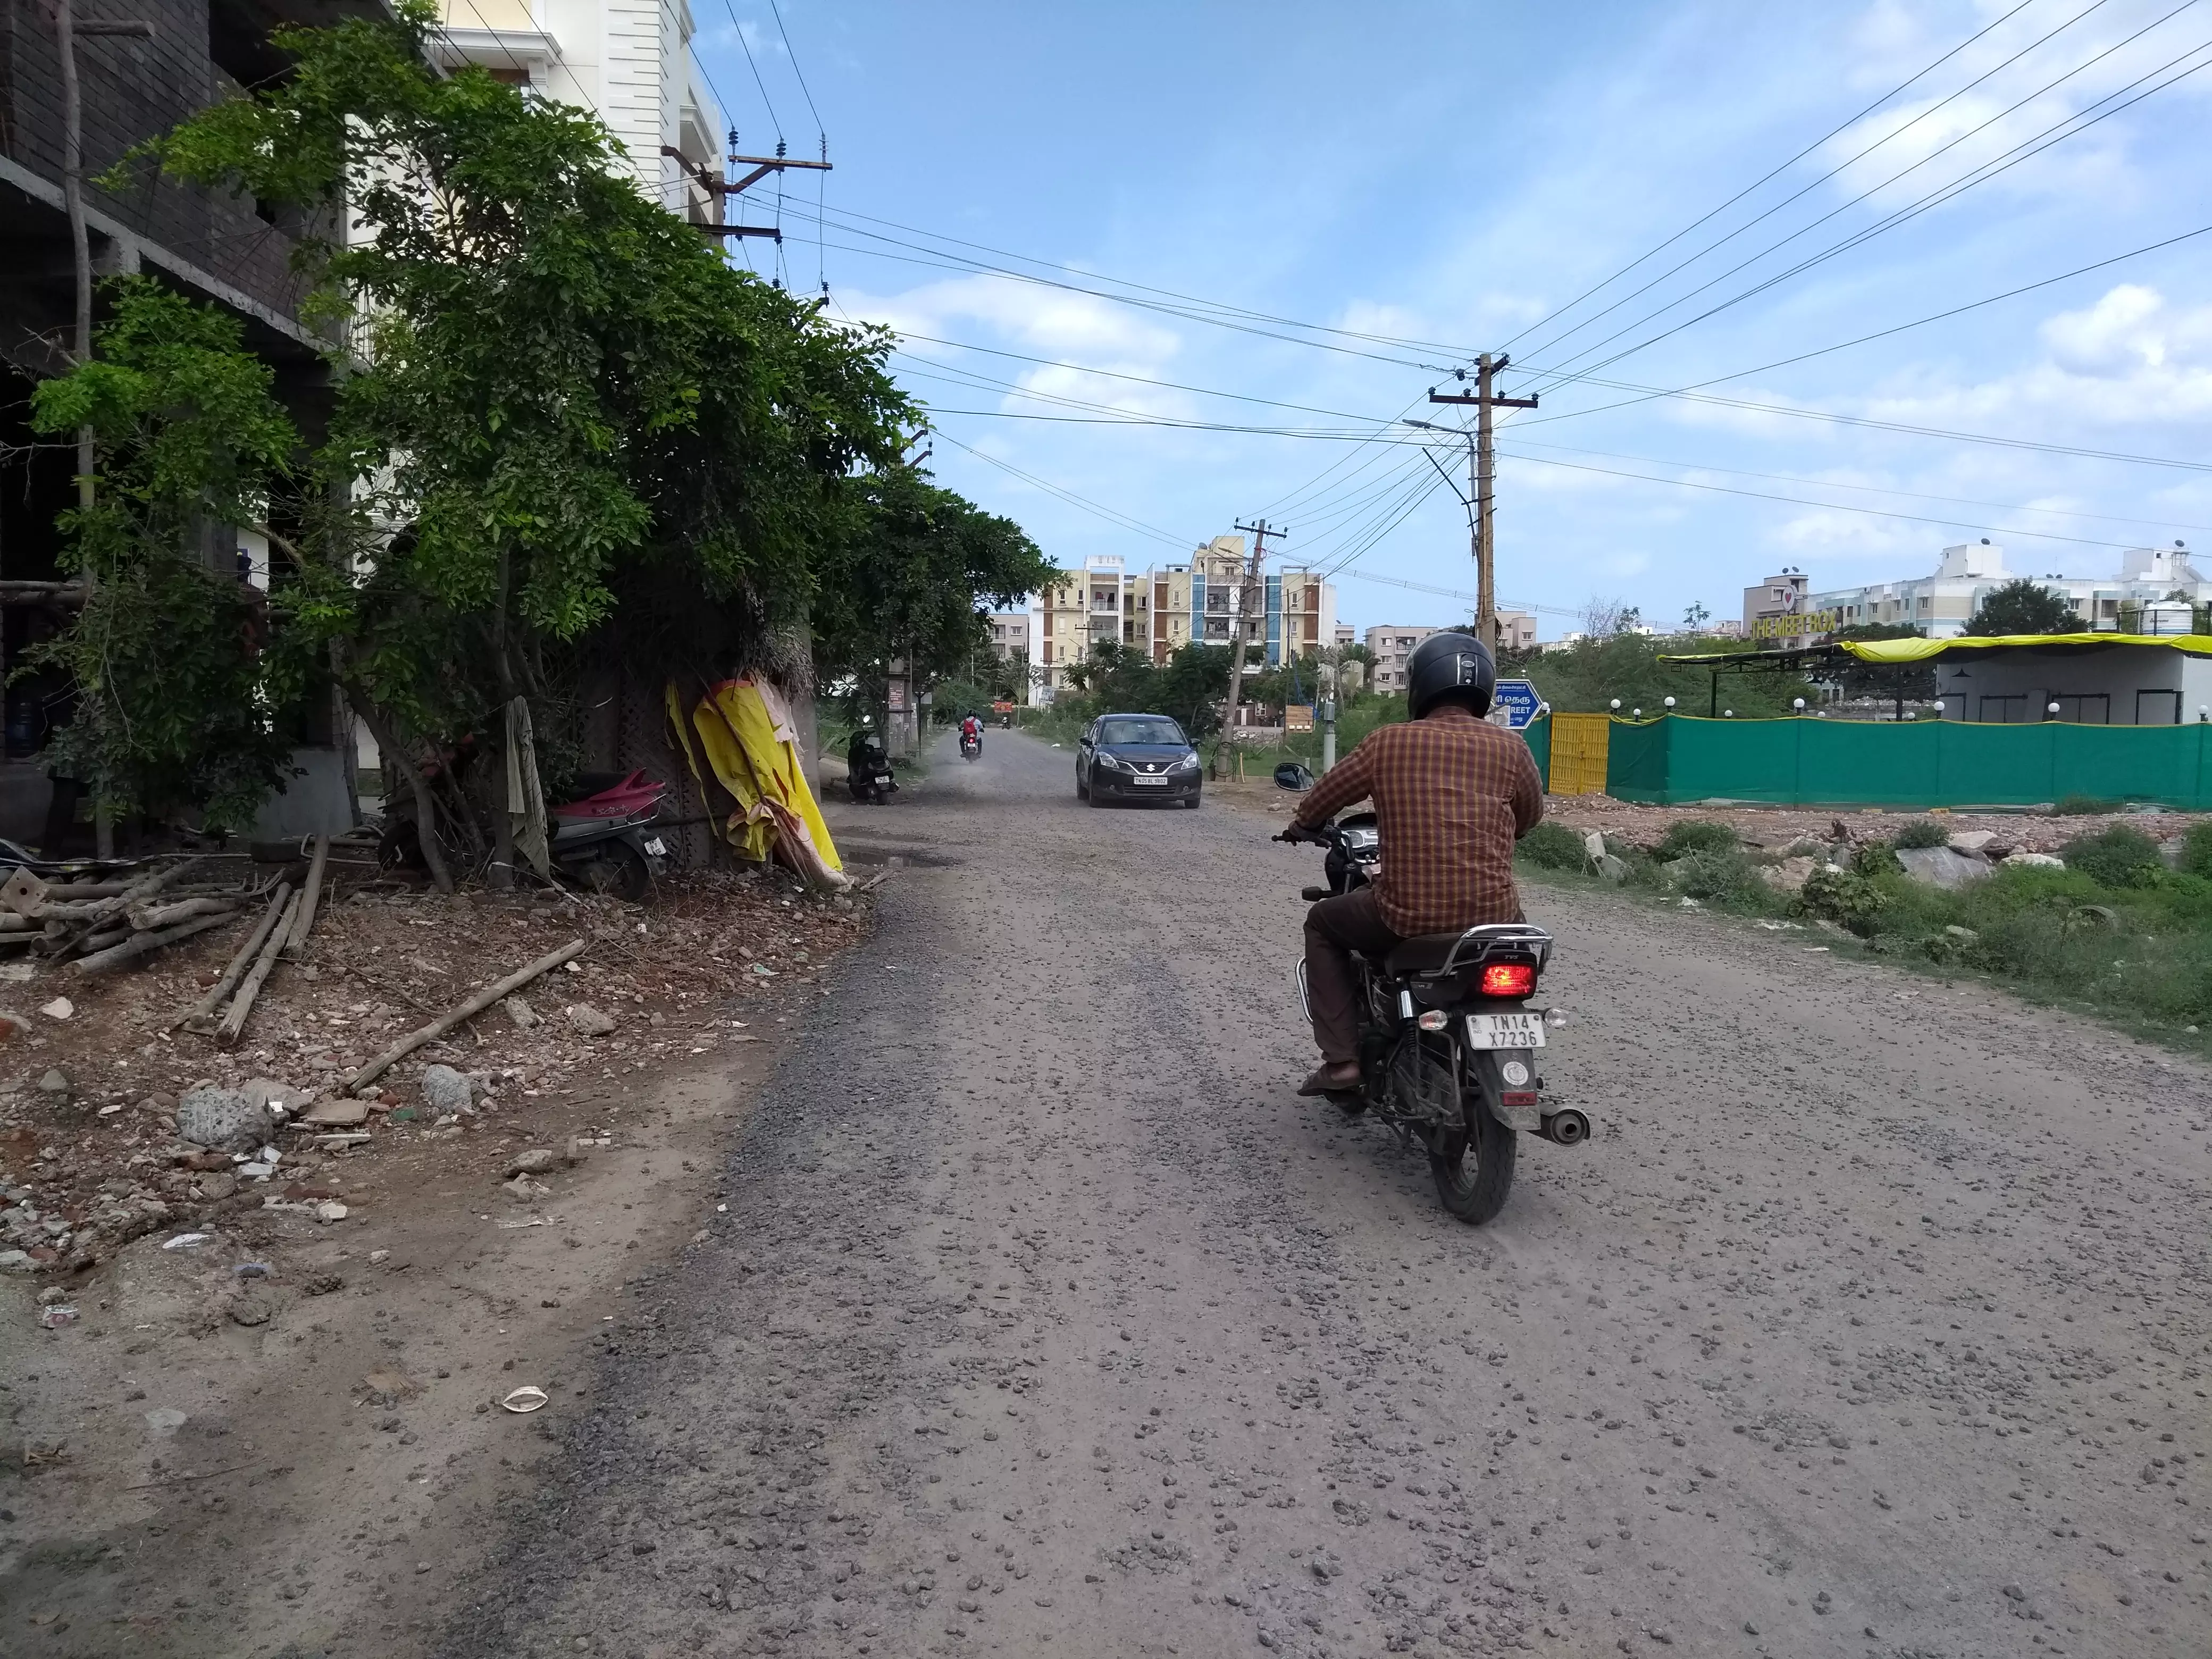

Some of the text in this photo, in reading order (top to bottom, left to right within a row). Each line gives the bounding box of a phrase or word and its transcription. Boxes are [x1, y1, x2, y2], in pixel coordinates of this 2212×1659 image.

[1752, 611, 1837, 638] THE MEET BOX
[1490, 1016, 1529, 1030] TN14
[1489, 1031, 1537, 1046] X7236
